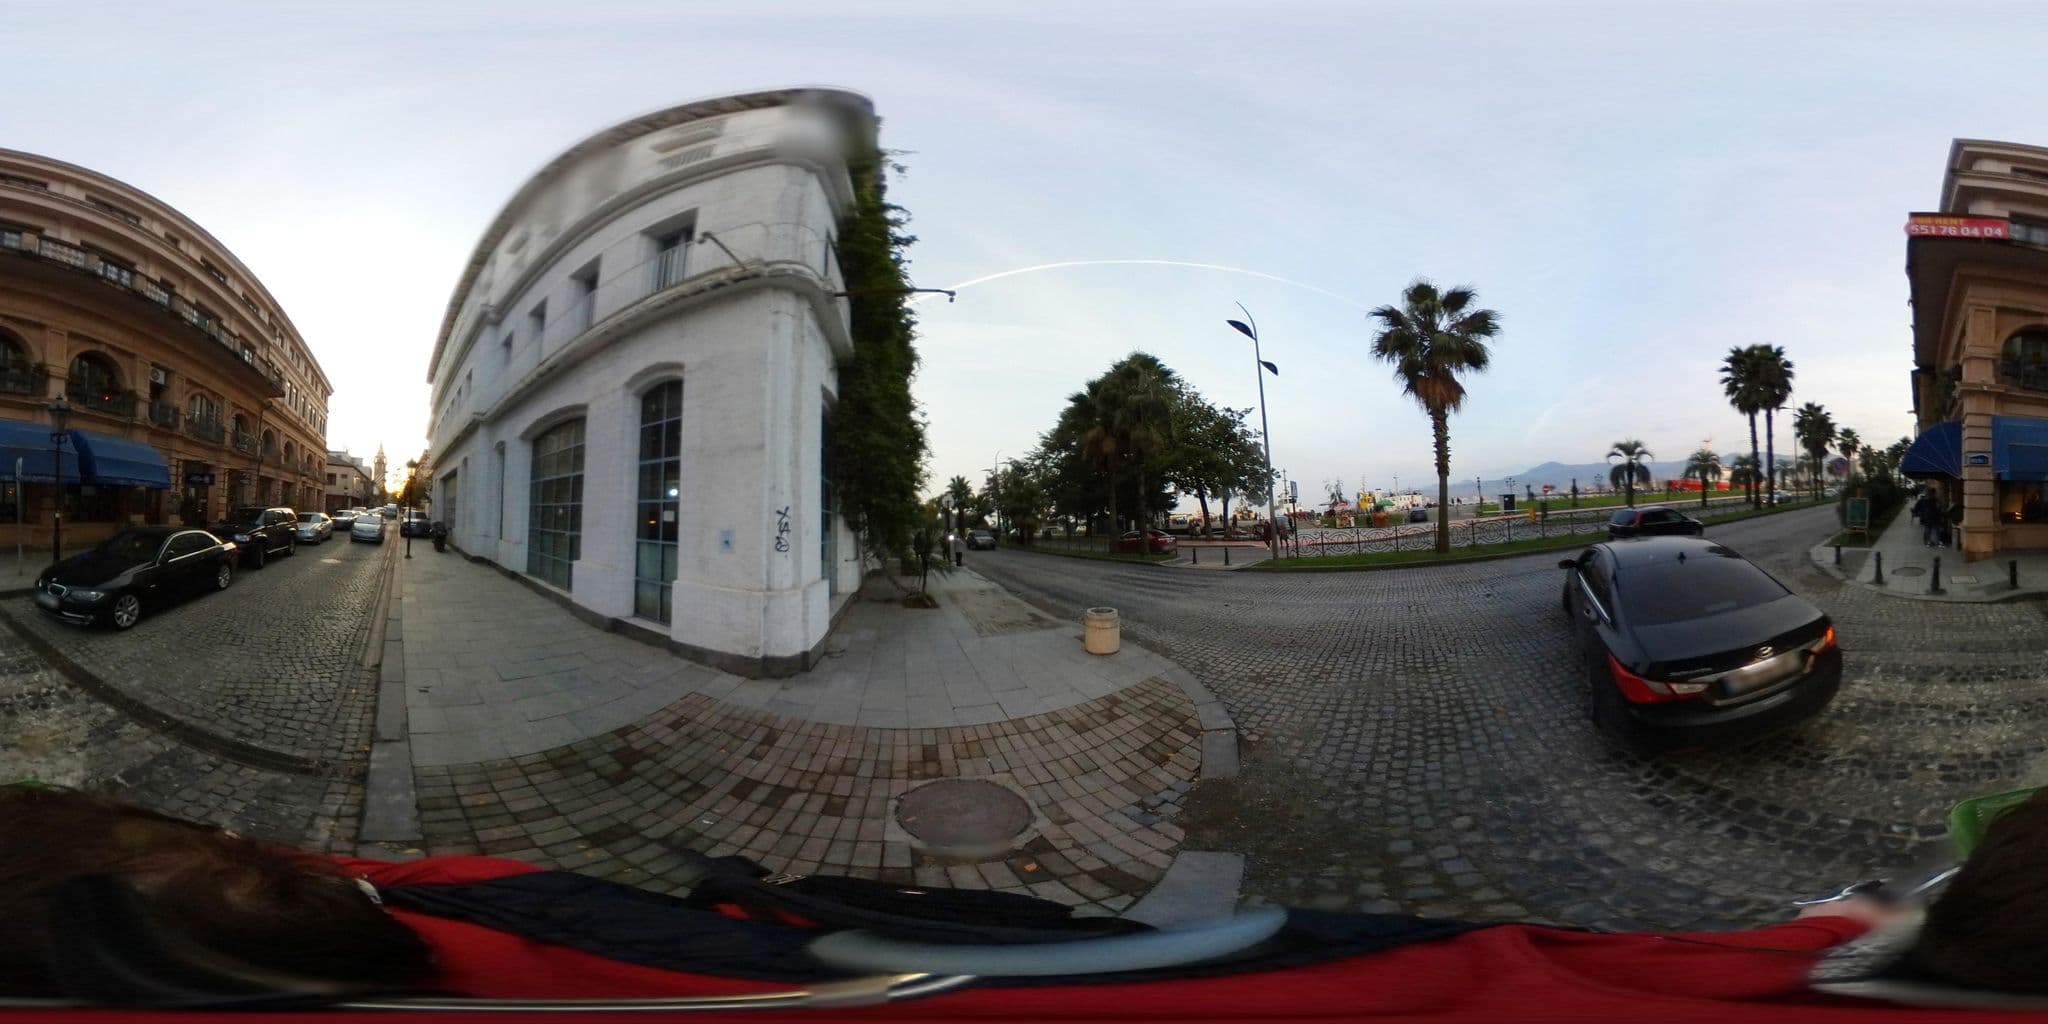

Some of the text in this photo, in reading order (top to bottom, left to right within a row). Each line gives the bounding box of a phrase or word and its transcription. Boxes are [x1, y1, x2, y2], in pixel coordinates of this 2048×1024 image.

[1911, 224, 2003, 238] 551 76 04 04
